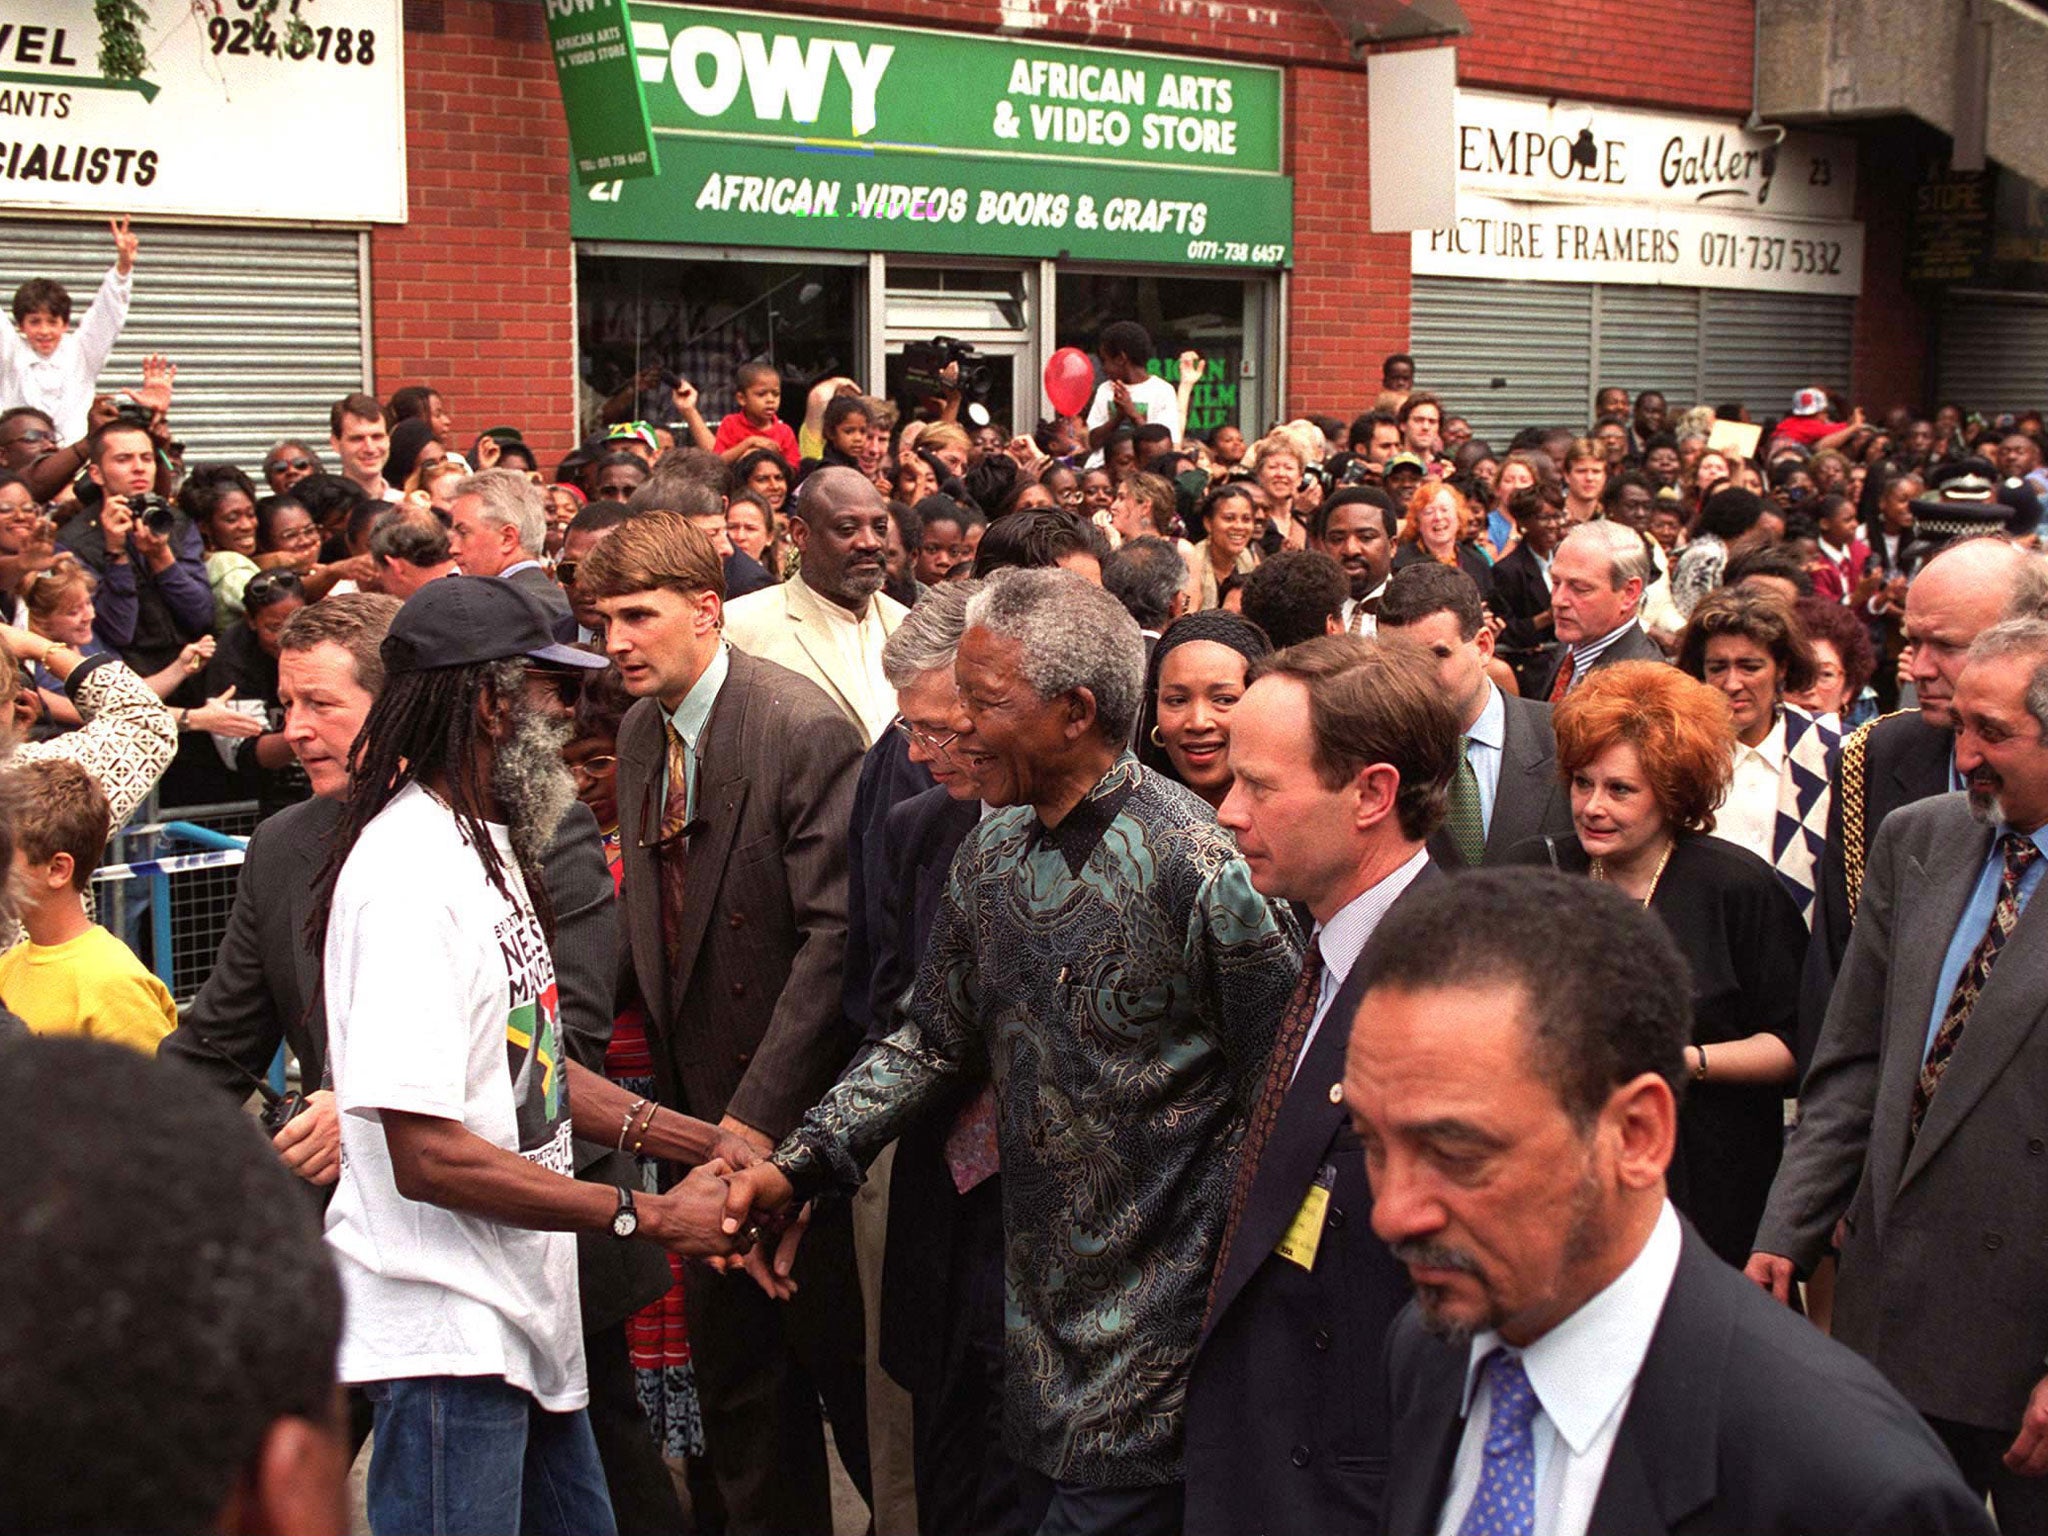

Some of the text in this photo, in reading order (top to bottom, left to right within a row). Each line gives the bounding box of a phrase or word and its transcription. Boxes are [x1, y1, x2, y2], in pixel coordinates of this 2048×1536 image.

[208, 17, 276, 57] 924
[1008, 58, 1233, 114] AFRICAN ARTS
[993, 100, 1238, 156] & VIDEO STORE
[694, 171, 1209, 237] AFRICAN VIDEOS BOOKS & CRAFTS
[1187, 240, 1249, 262] 0171-738
[1430, 217, 1544, 259] PICTURE
[1556, 223, 1680, 265] FRAMERS
[1791, 238, 1842, 275] 5332
